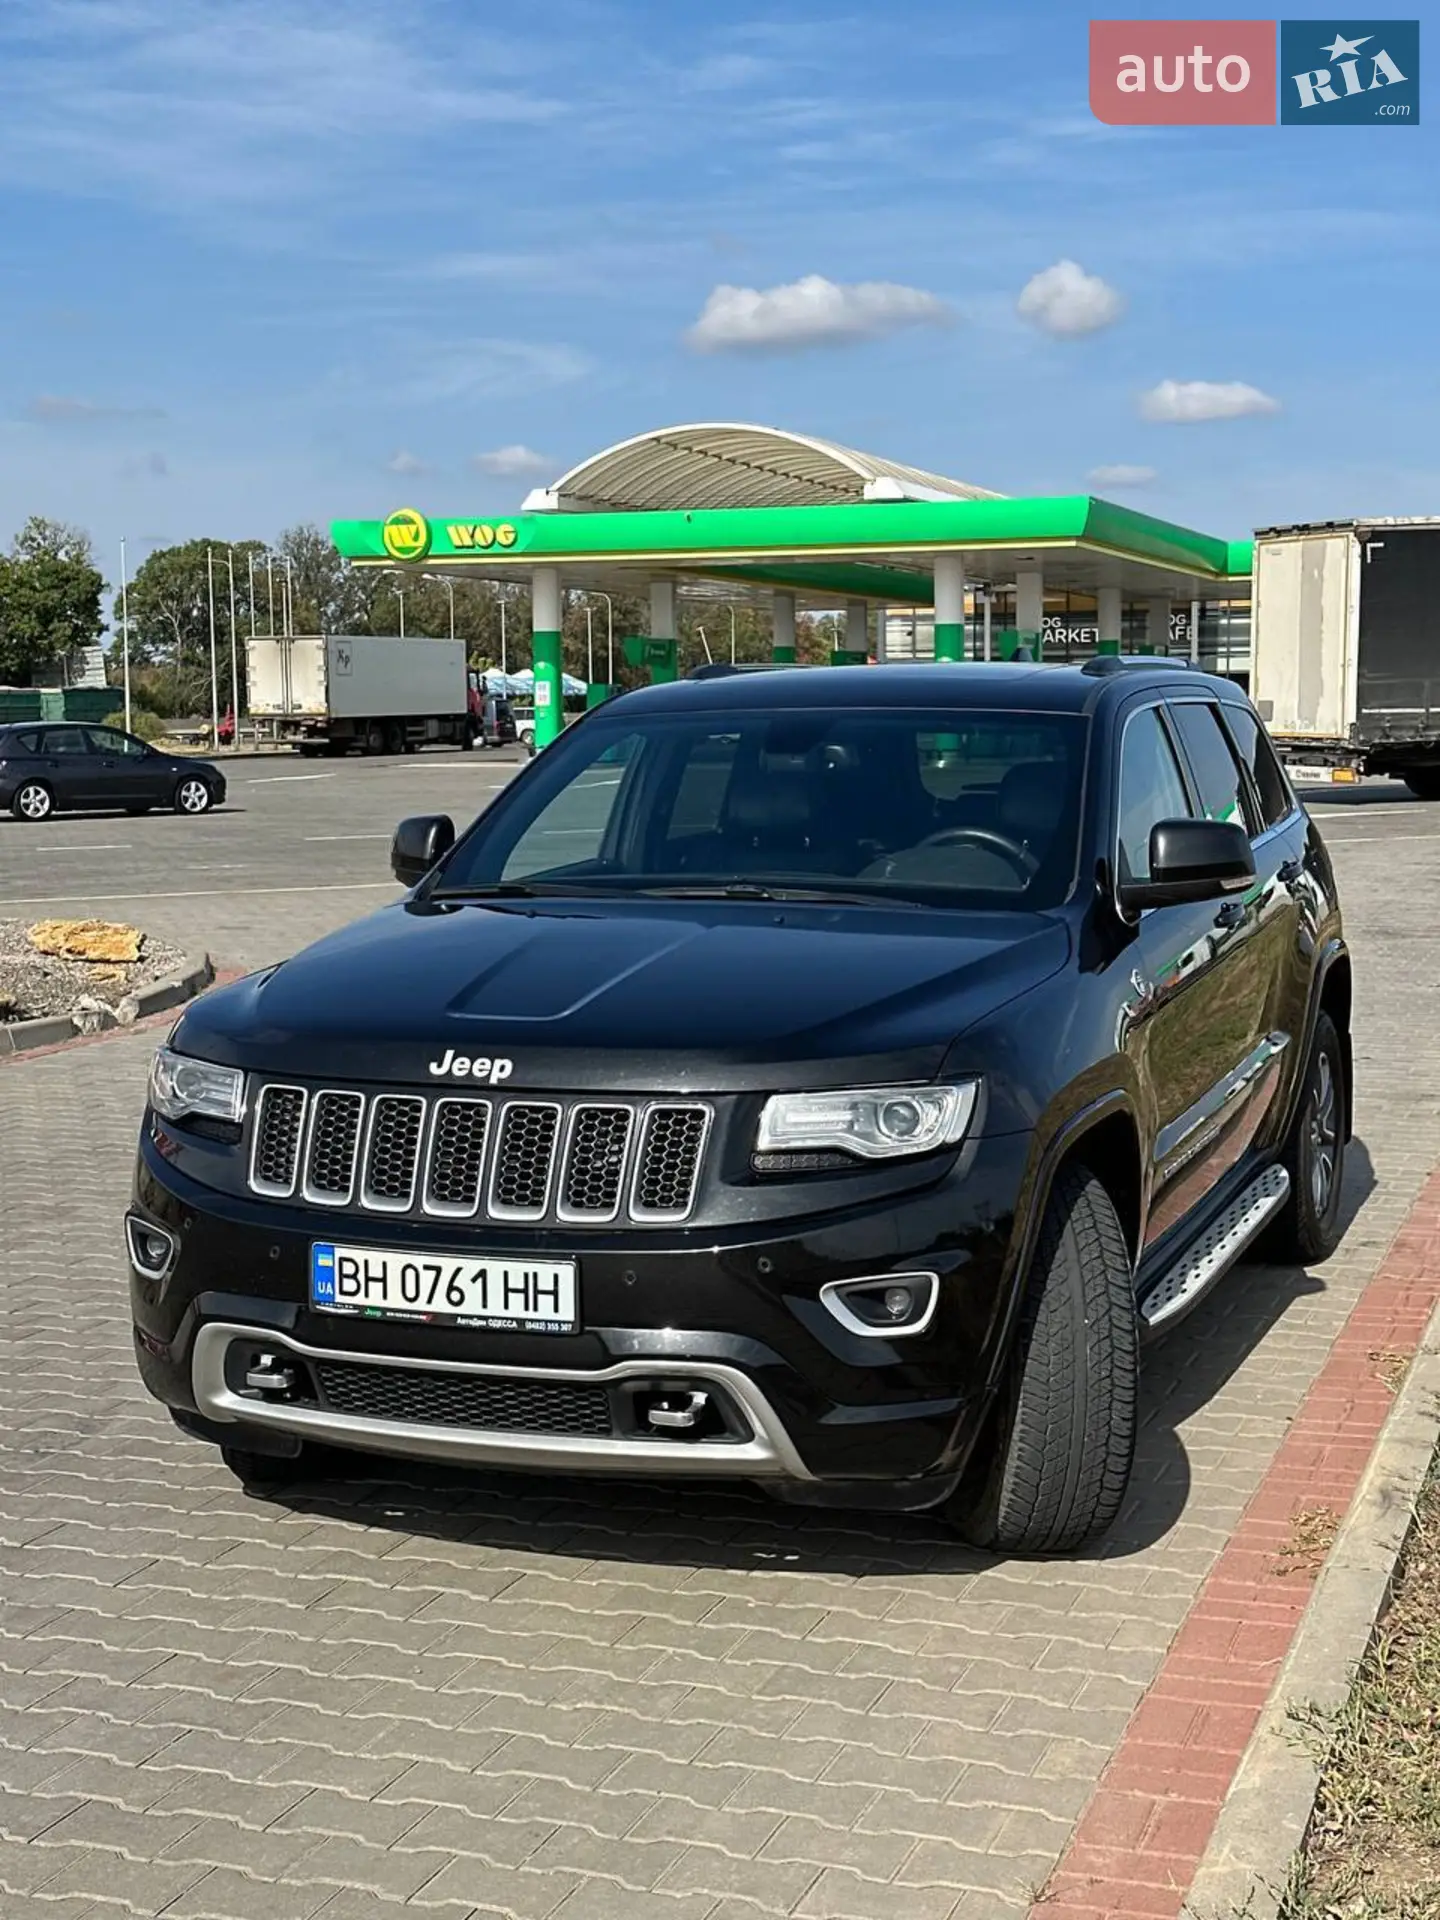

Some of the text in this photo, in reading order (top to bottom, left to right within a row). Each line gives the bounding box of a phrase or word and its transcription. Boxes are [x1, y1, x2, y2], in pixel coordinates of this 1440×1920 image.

[446, 523, 517, 548] WOG
[1042, 617, 1062, 629] OG
[1042, 628, 1099, 643] ARKET
[429, 1049, 513, 1084] Jeep
[317, 1281, 334, 1295] UA
[338, 1256, 559, 1314] BH 0761 HH
